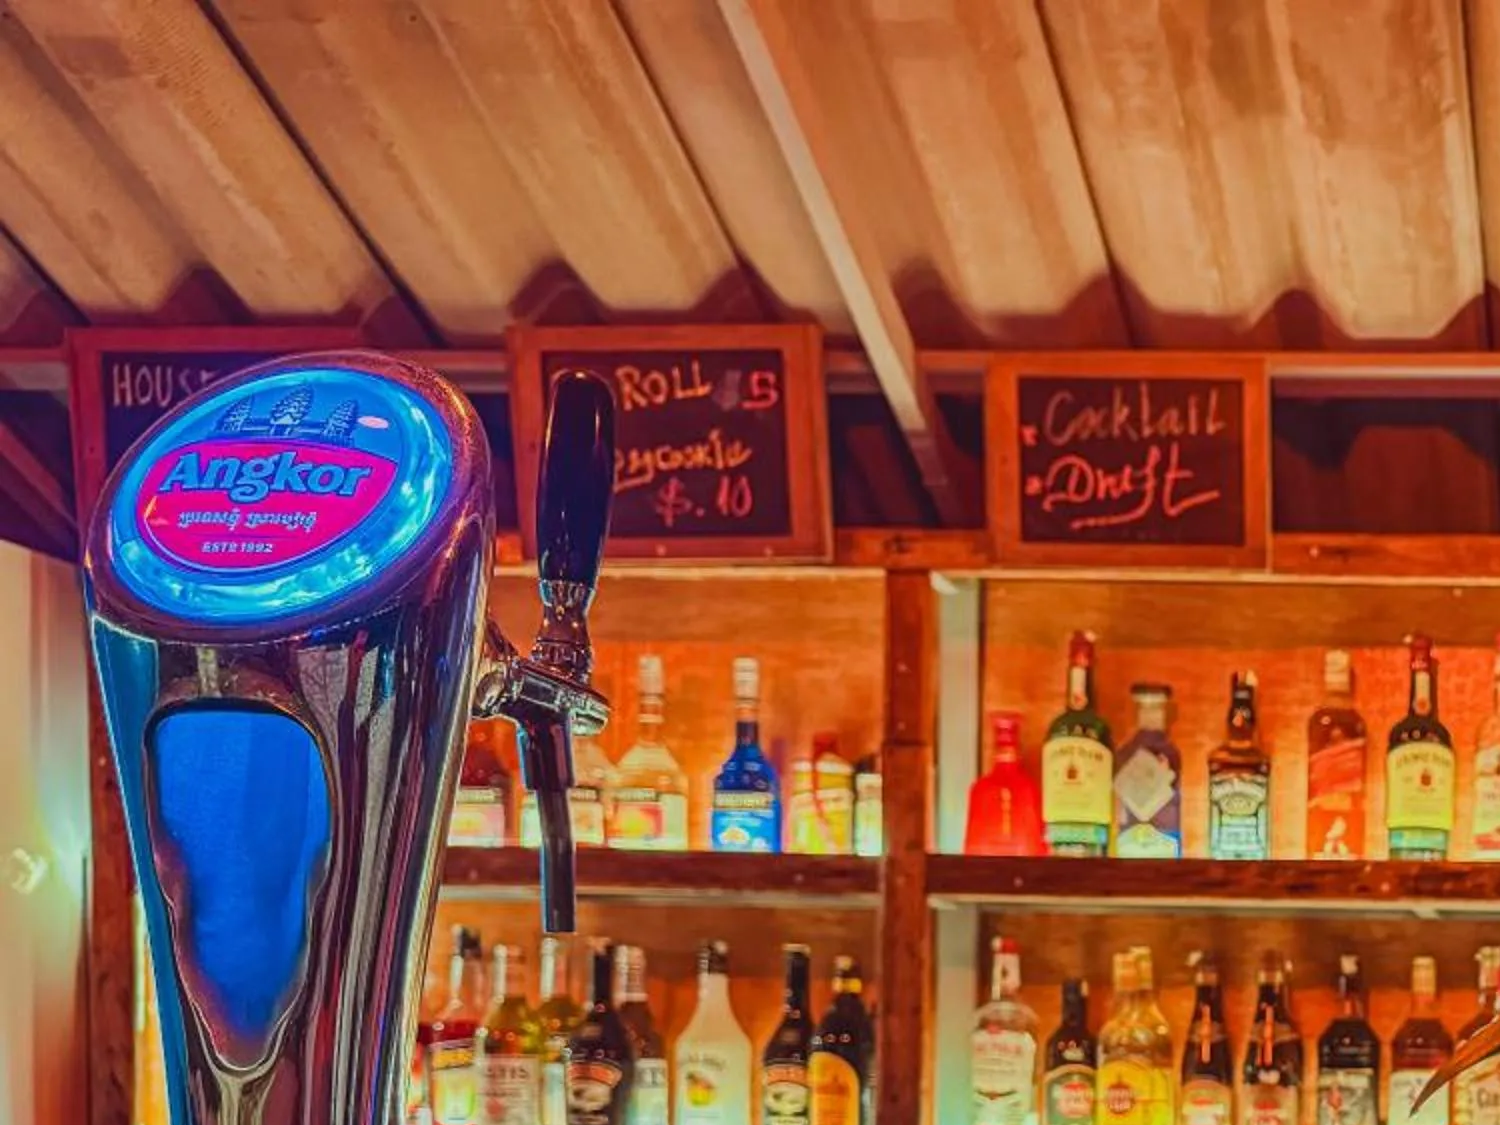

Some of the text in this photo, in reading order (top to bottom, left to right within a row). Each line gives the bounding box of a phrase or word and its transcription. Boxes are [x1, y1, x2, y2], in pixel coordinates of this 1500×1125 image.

[615, 360, 712, 411] ROLL
[157, 451, 374, 505] Angkor
[241, 541, 274, 553] 1992
